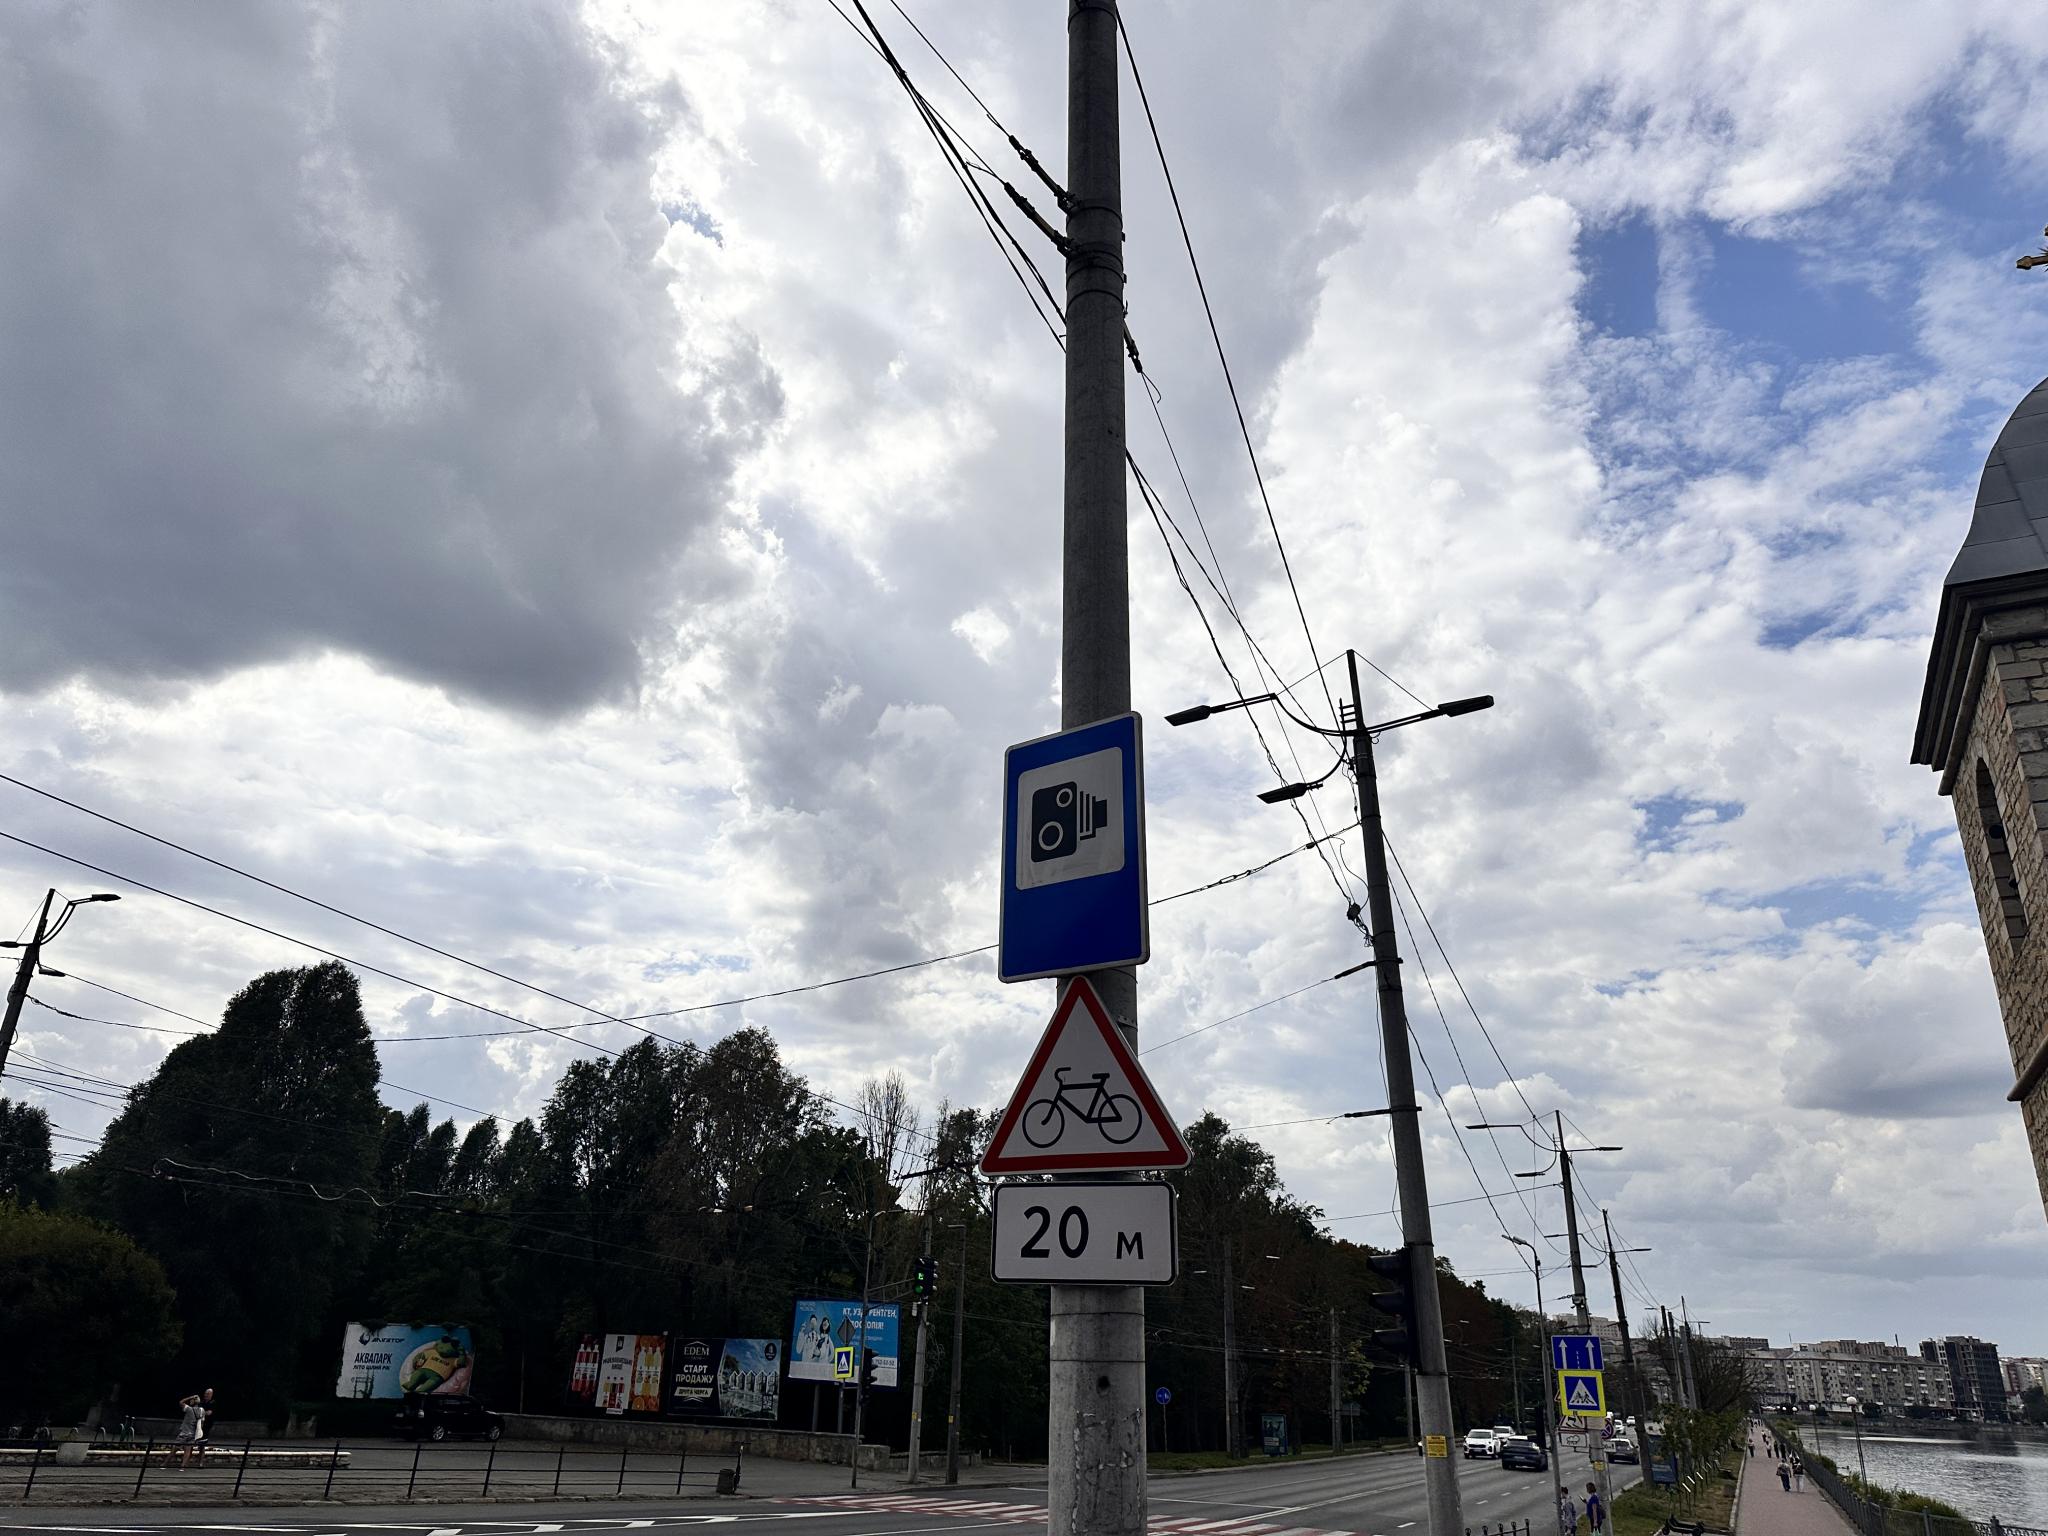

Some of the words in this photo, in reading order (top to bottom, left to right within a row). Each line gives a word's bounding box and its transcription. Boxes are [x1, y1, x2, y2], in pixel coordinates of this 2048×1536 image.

[1020, 1205, 1089, 1259] 20
[683, 1346, 710, 1356] EDEM
[354, 1353, 393, 1364] АКВАПАРК
[683, 1364, 709, 1374] СТАРТ
[675, 1373, 715, 1385] ПРОДАЖУ
